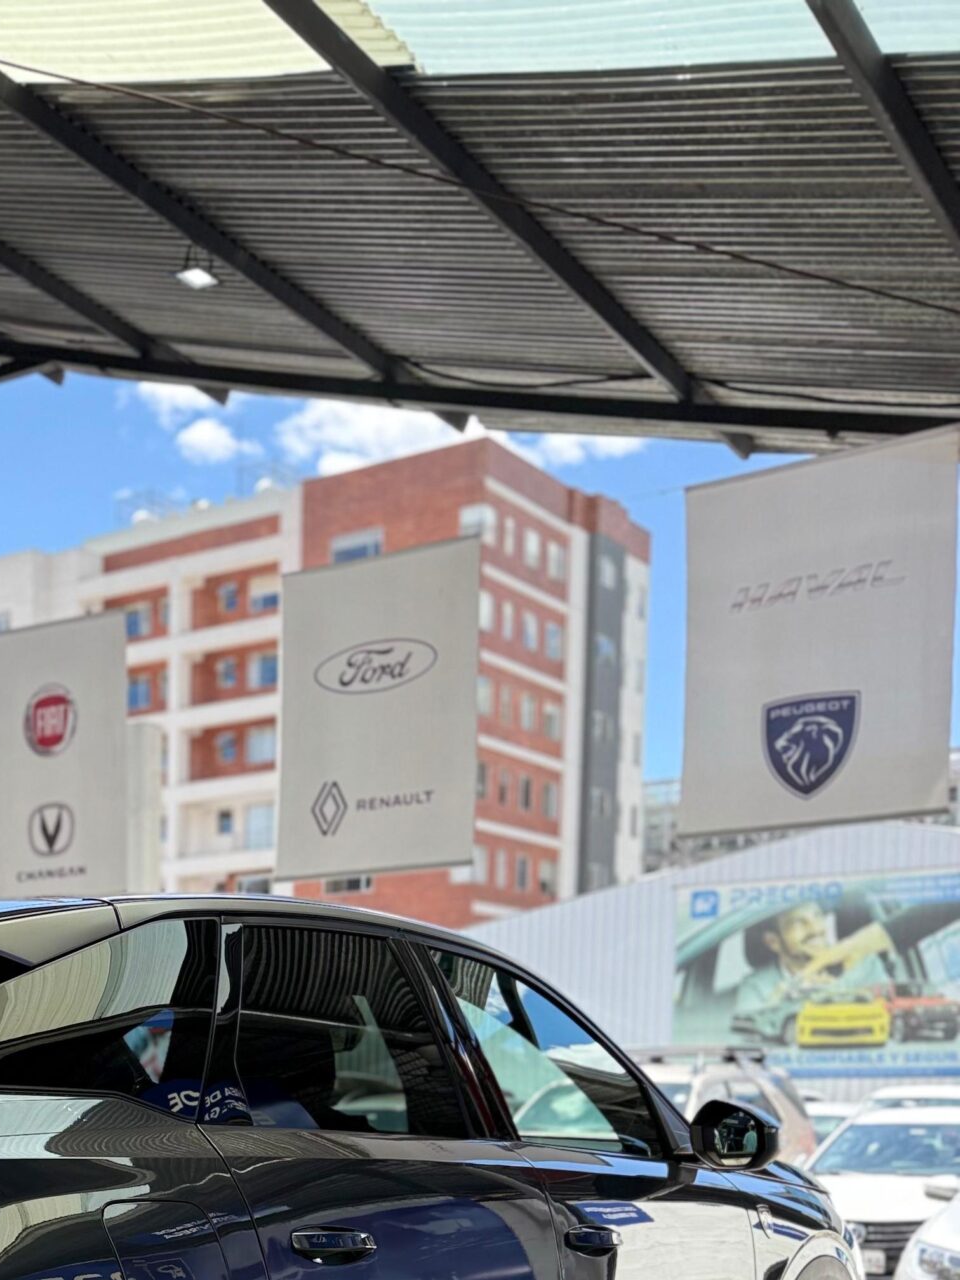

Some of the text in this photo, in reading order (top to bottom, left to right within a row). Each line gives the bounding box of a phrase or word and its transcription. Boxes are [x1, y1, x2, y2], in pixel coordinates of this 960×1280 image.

[339, 647, 414, 687] Ford
[769, 700, 851, 719] PEUGEOT
[36, 706, 67, 739] FIAT
[355, 790, 435, 812] RENAULT
[16, 866, 88, 883] CHANGAN
